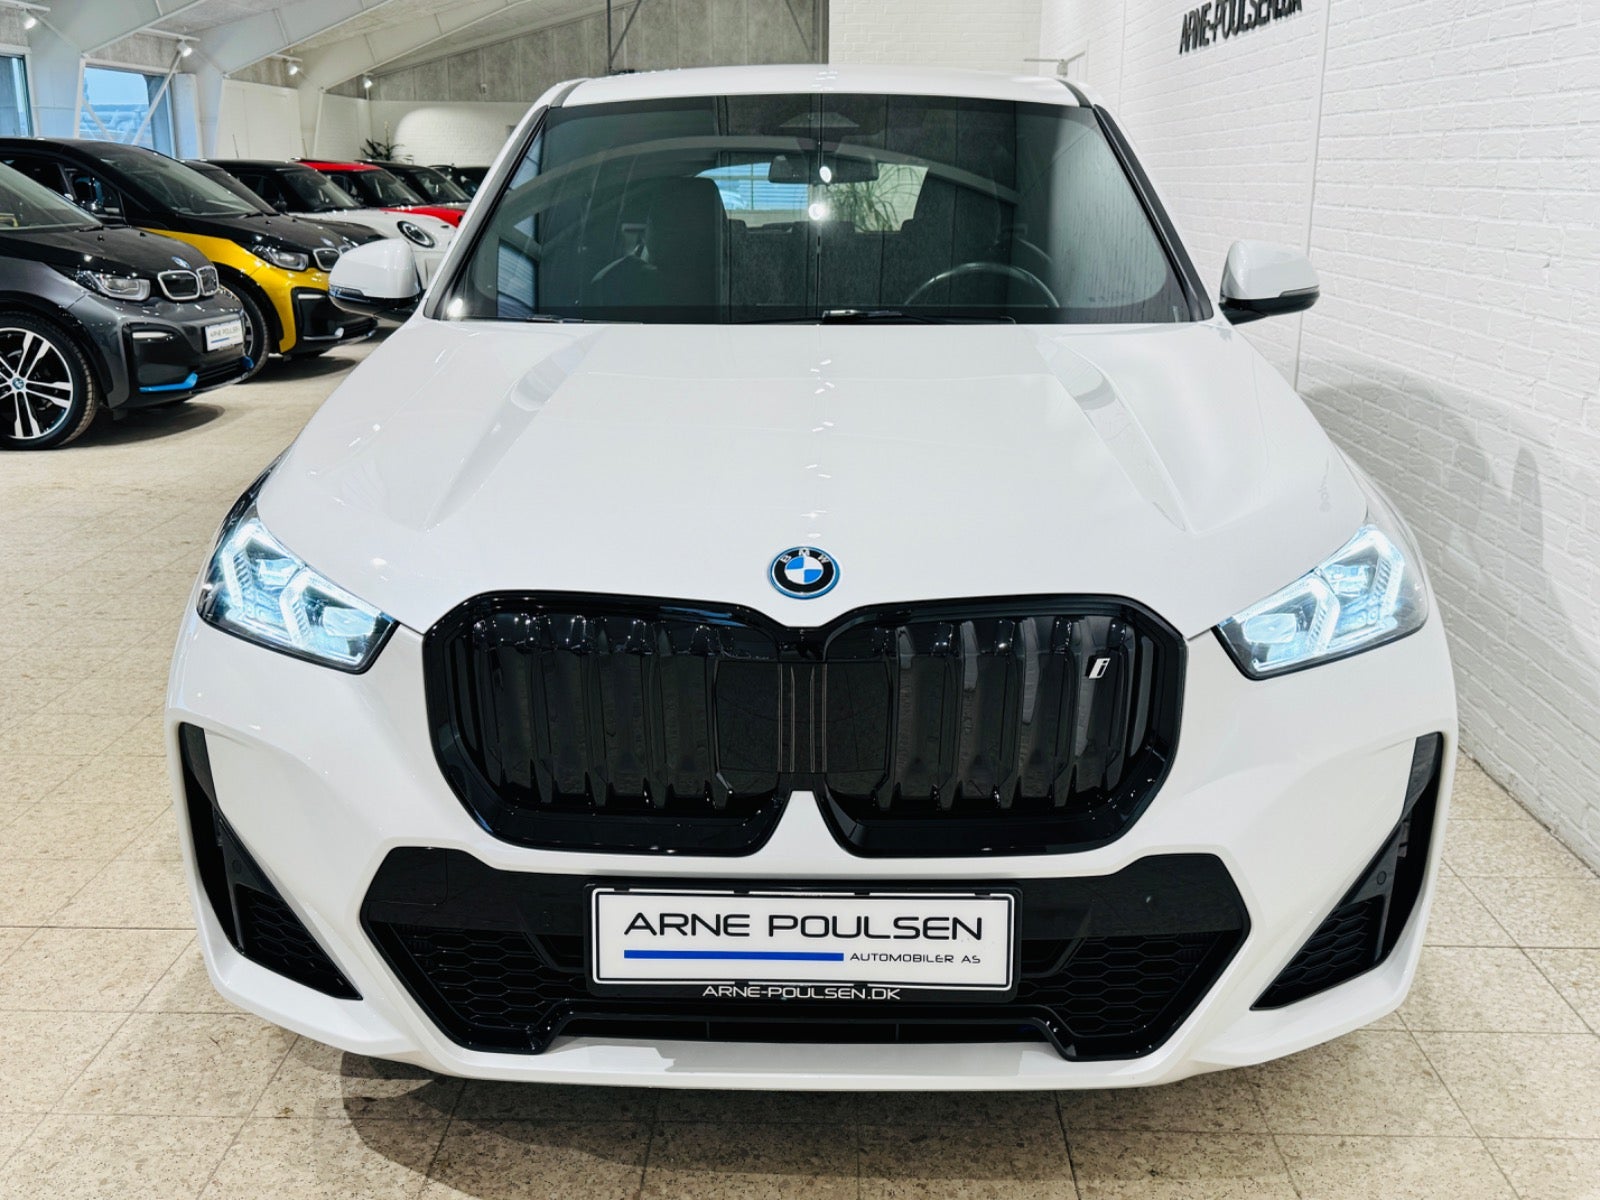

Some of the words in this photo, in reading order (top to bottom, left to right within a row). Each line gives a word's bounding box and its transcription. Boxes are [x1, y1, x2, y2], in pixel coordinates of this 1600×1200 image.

[624, 912, 750, 937] ARNE
[768, 914, 982, 941] POULSEN
[849, 952, 954, 964] AUTOMOBILER
[961, 954, 981, 964] AS
[702, 985, 901, 1000] ARNE-POULSEN.DK
